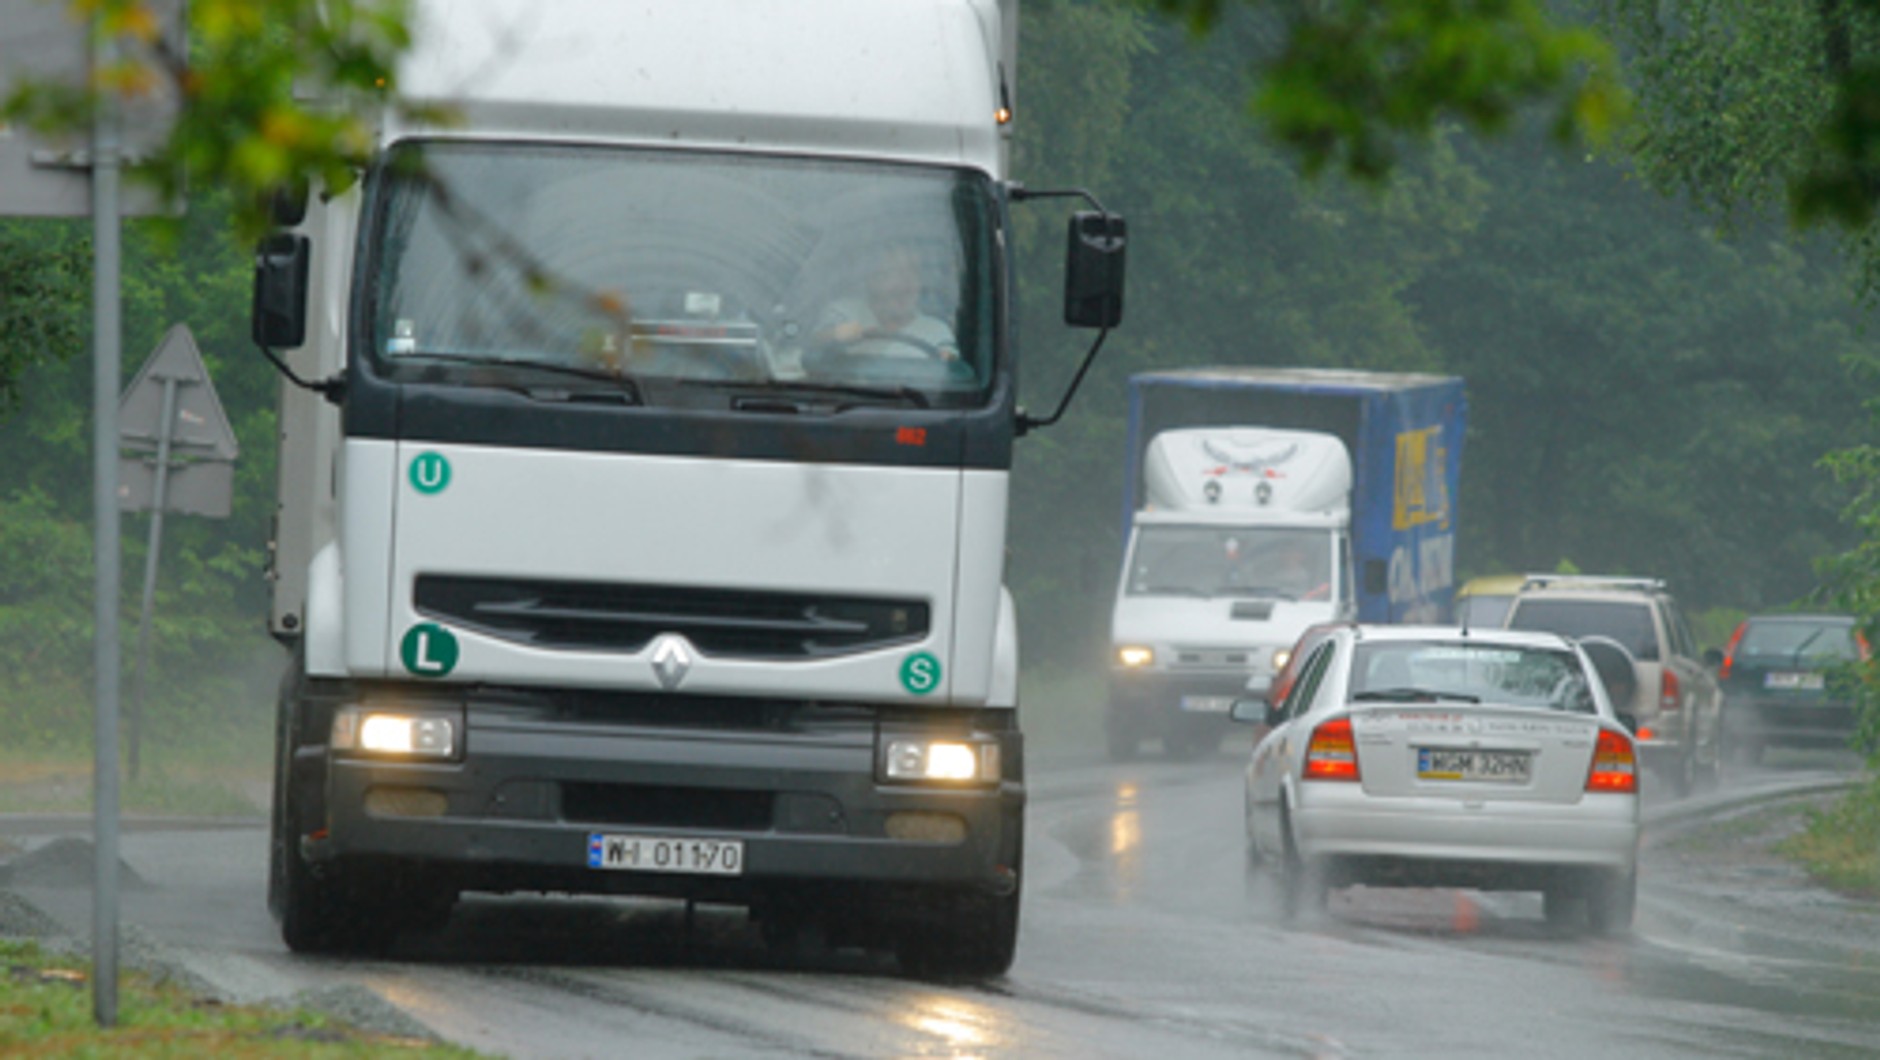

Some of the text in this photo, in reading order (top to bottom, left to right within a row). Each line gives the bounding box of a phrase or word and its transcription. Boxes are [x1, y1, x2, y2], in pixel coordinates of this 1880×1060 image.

[418, 459, 442, 486] U
[416, 632, 443, 671] L
[909, 658, 933, 689] S
